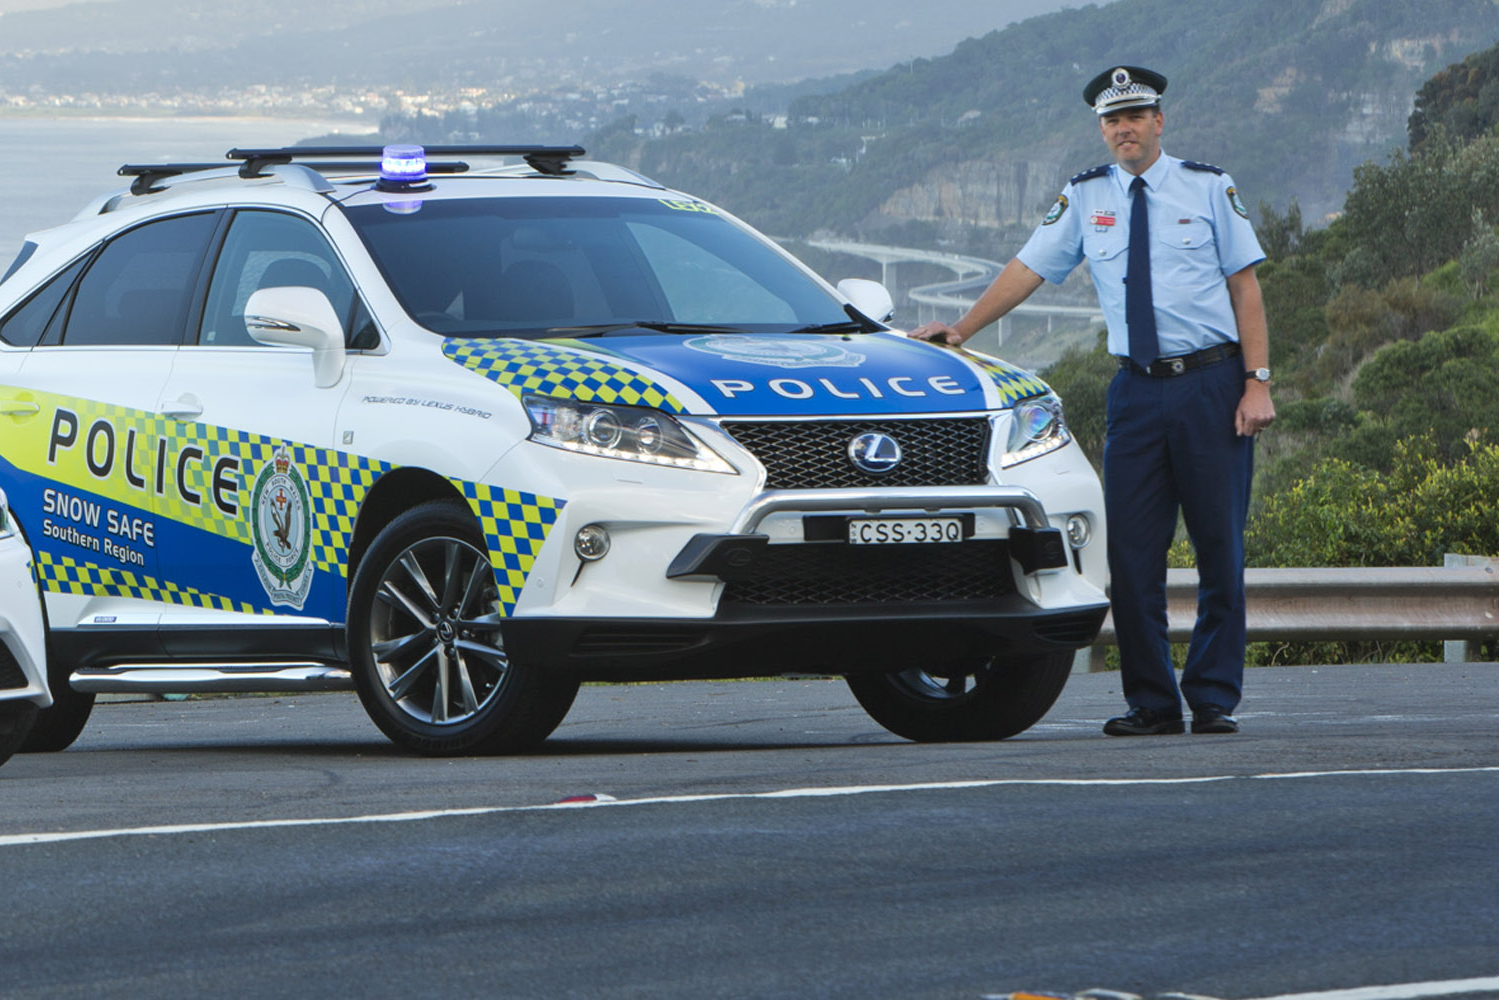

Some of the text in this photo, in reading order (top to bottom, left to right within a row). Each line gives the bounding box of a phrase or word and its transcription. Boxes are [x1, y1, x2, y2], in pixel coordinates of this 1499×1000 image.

[421, 400, 454, 410] LEXUS
[454, 406, 492, 419] HYBRID
[710, 376, 967, 398] POLICE
[47, 406, 242, 518] POLICE
[43, 488, 155, 547] SNOW SAFE
[43, 519, 145, 566] Southern Region
